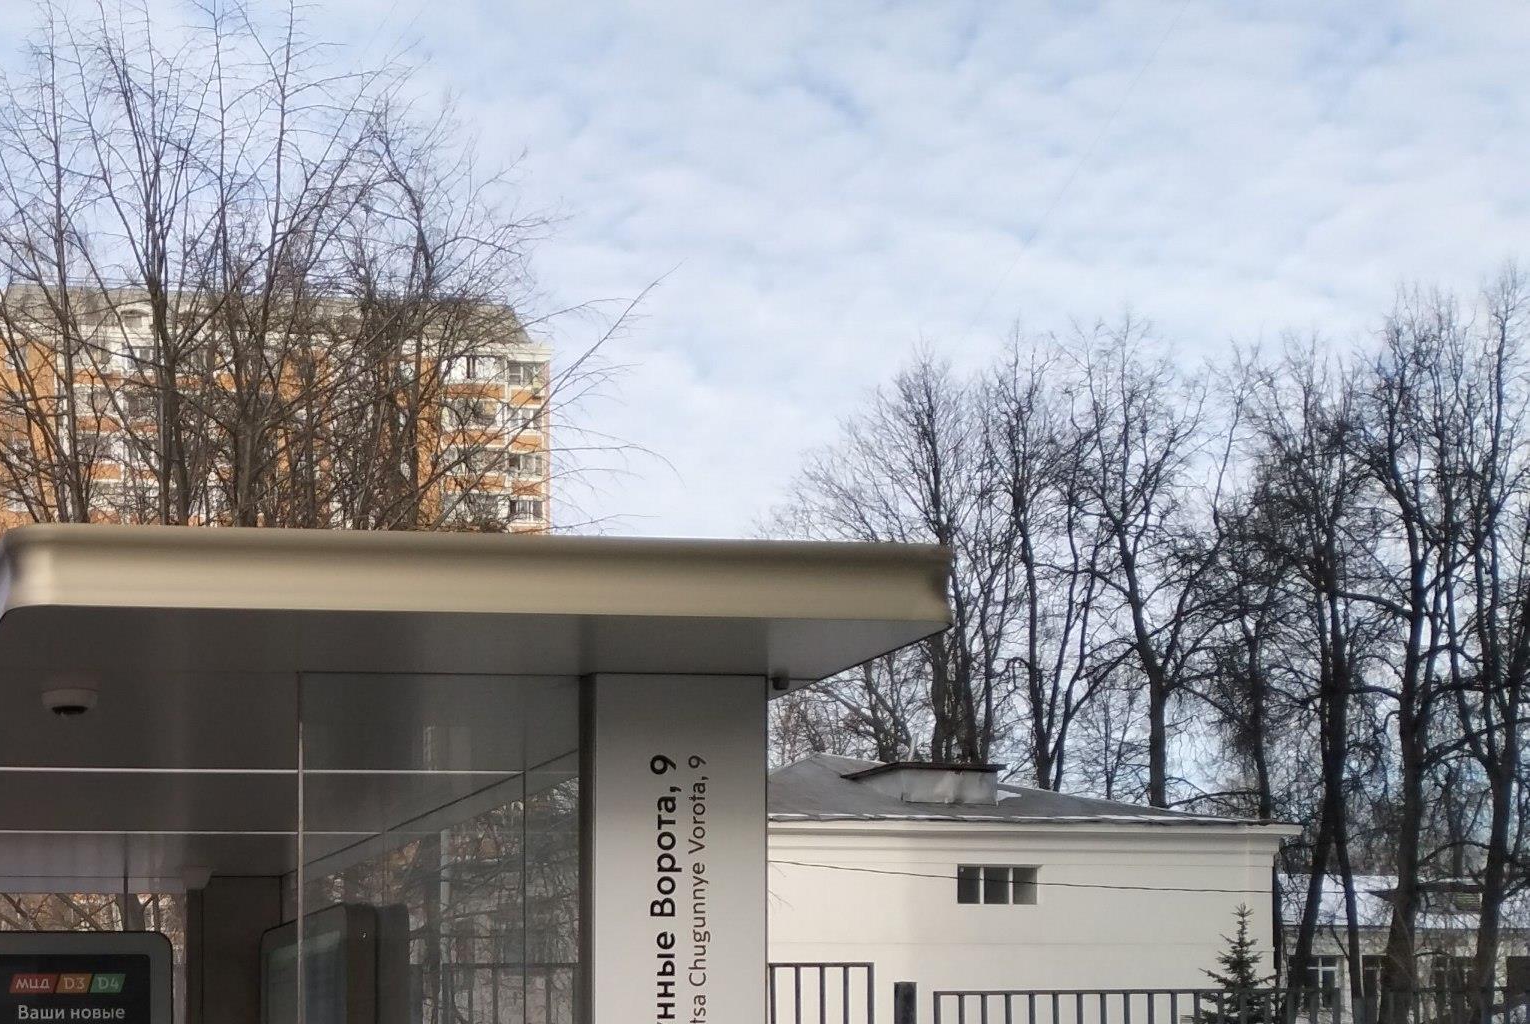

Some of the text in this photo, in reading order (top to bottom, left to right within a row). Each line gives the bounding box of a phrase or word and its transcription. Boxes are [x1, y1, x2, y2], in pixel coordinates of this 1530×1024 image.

[650, 754, 677, 774] 9
[688, 755, 707, 769] 9
[688, 776, 709, 853] Vorota,
[650, 784, 682, 918] Ворота,
[688, 861, 711, 987] Chugunnye
[15, 976, 119, 990] МЦД D3 D4
[18, 1004, 126, 1020] Ваши новые
